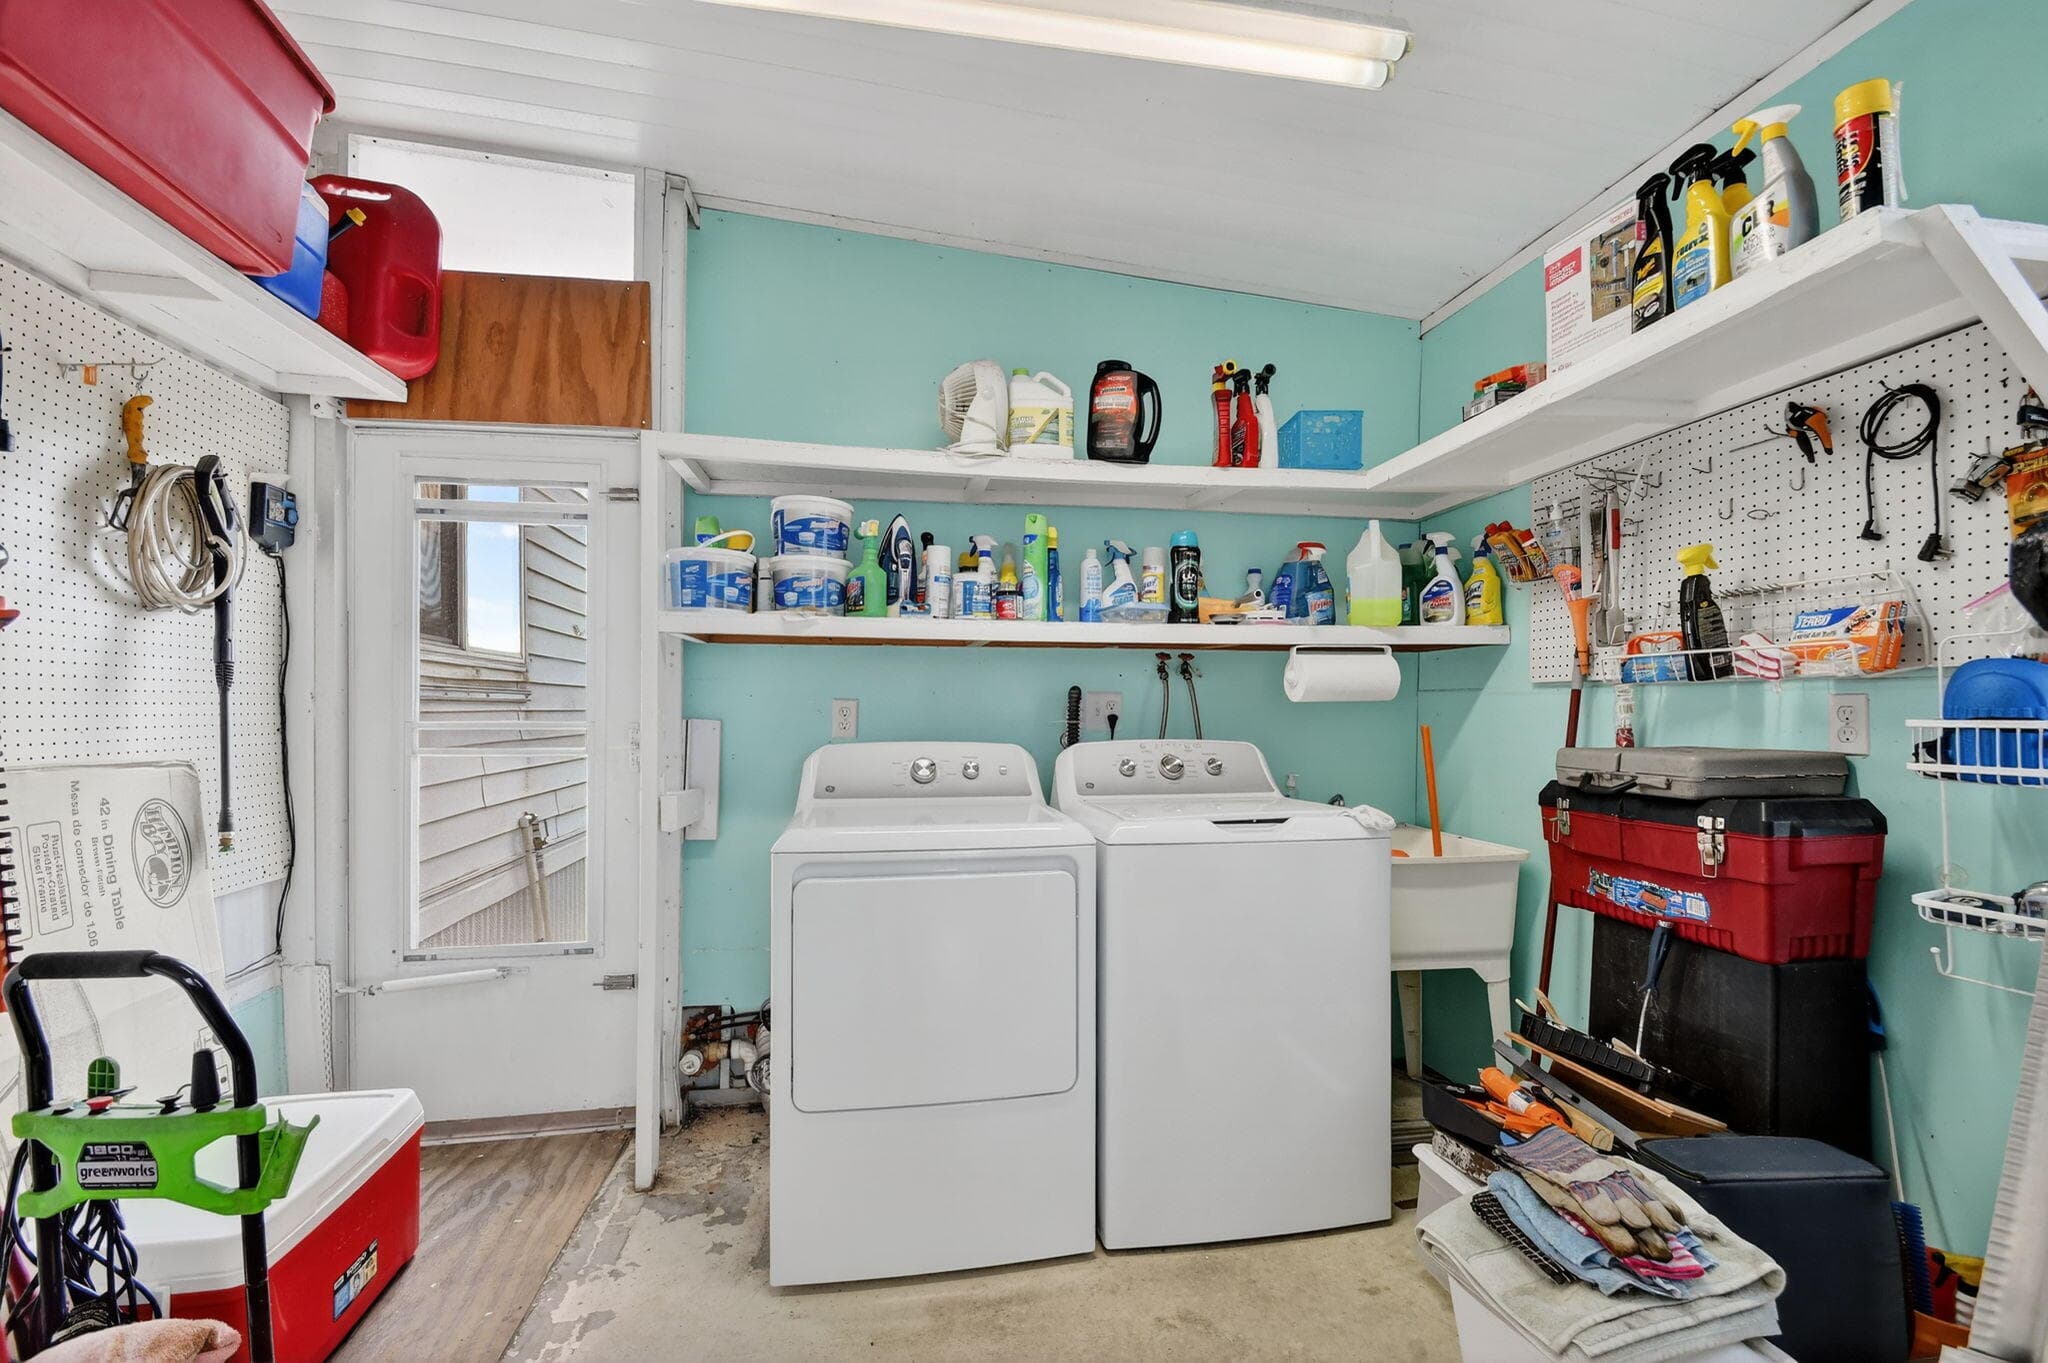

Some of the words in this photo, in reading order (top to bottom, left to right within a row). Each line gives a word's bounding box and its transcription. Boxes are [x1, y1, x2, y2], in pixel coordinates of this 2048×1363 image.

[69, 779, 81, 816] Mesa
[98, 797, 111, 816] 42
[71, 819, 83, 836] de
[100, 818, 110, 831] in
[73, 839, 92, 898] comedor
[102, 834, 119, 885] Dining
[83, 901, 95, 918] de
[109, 888, 126, 931] Table
[80, 1163, 156, 1180] greenworks
